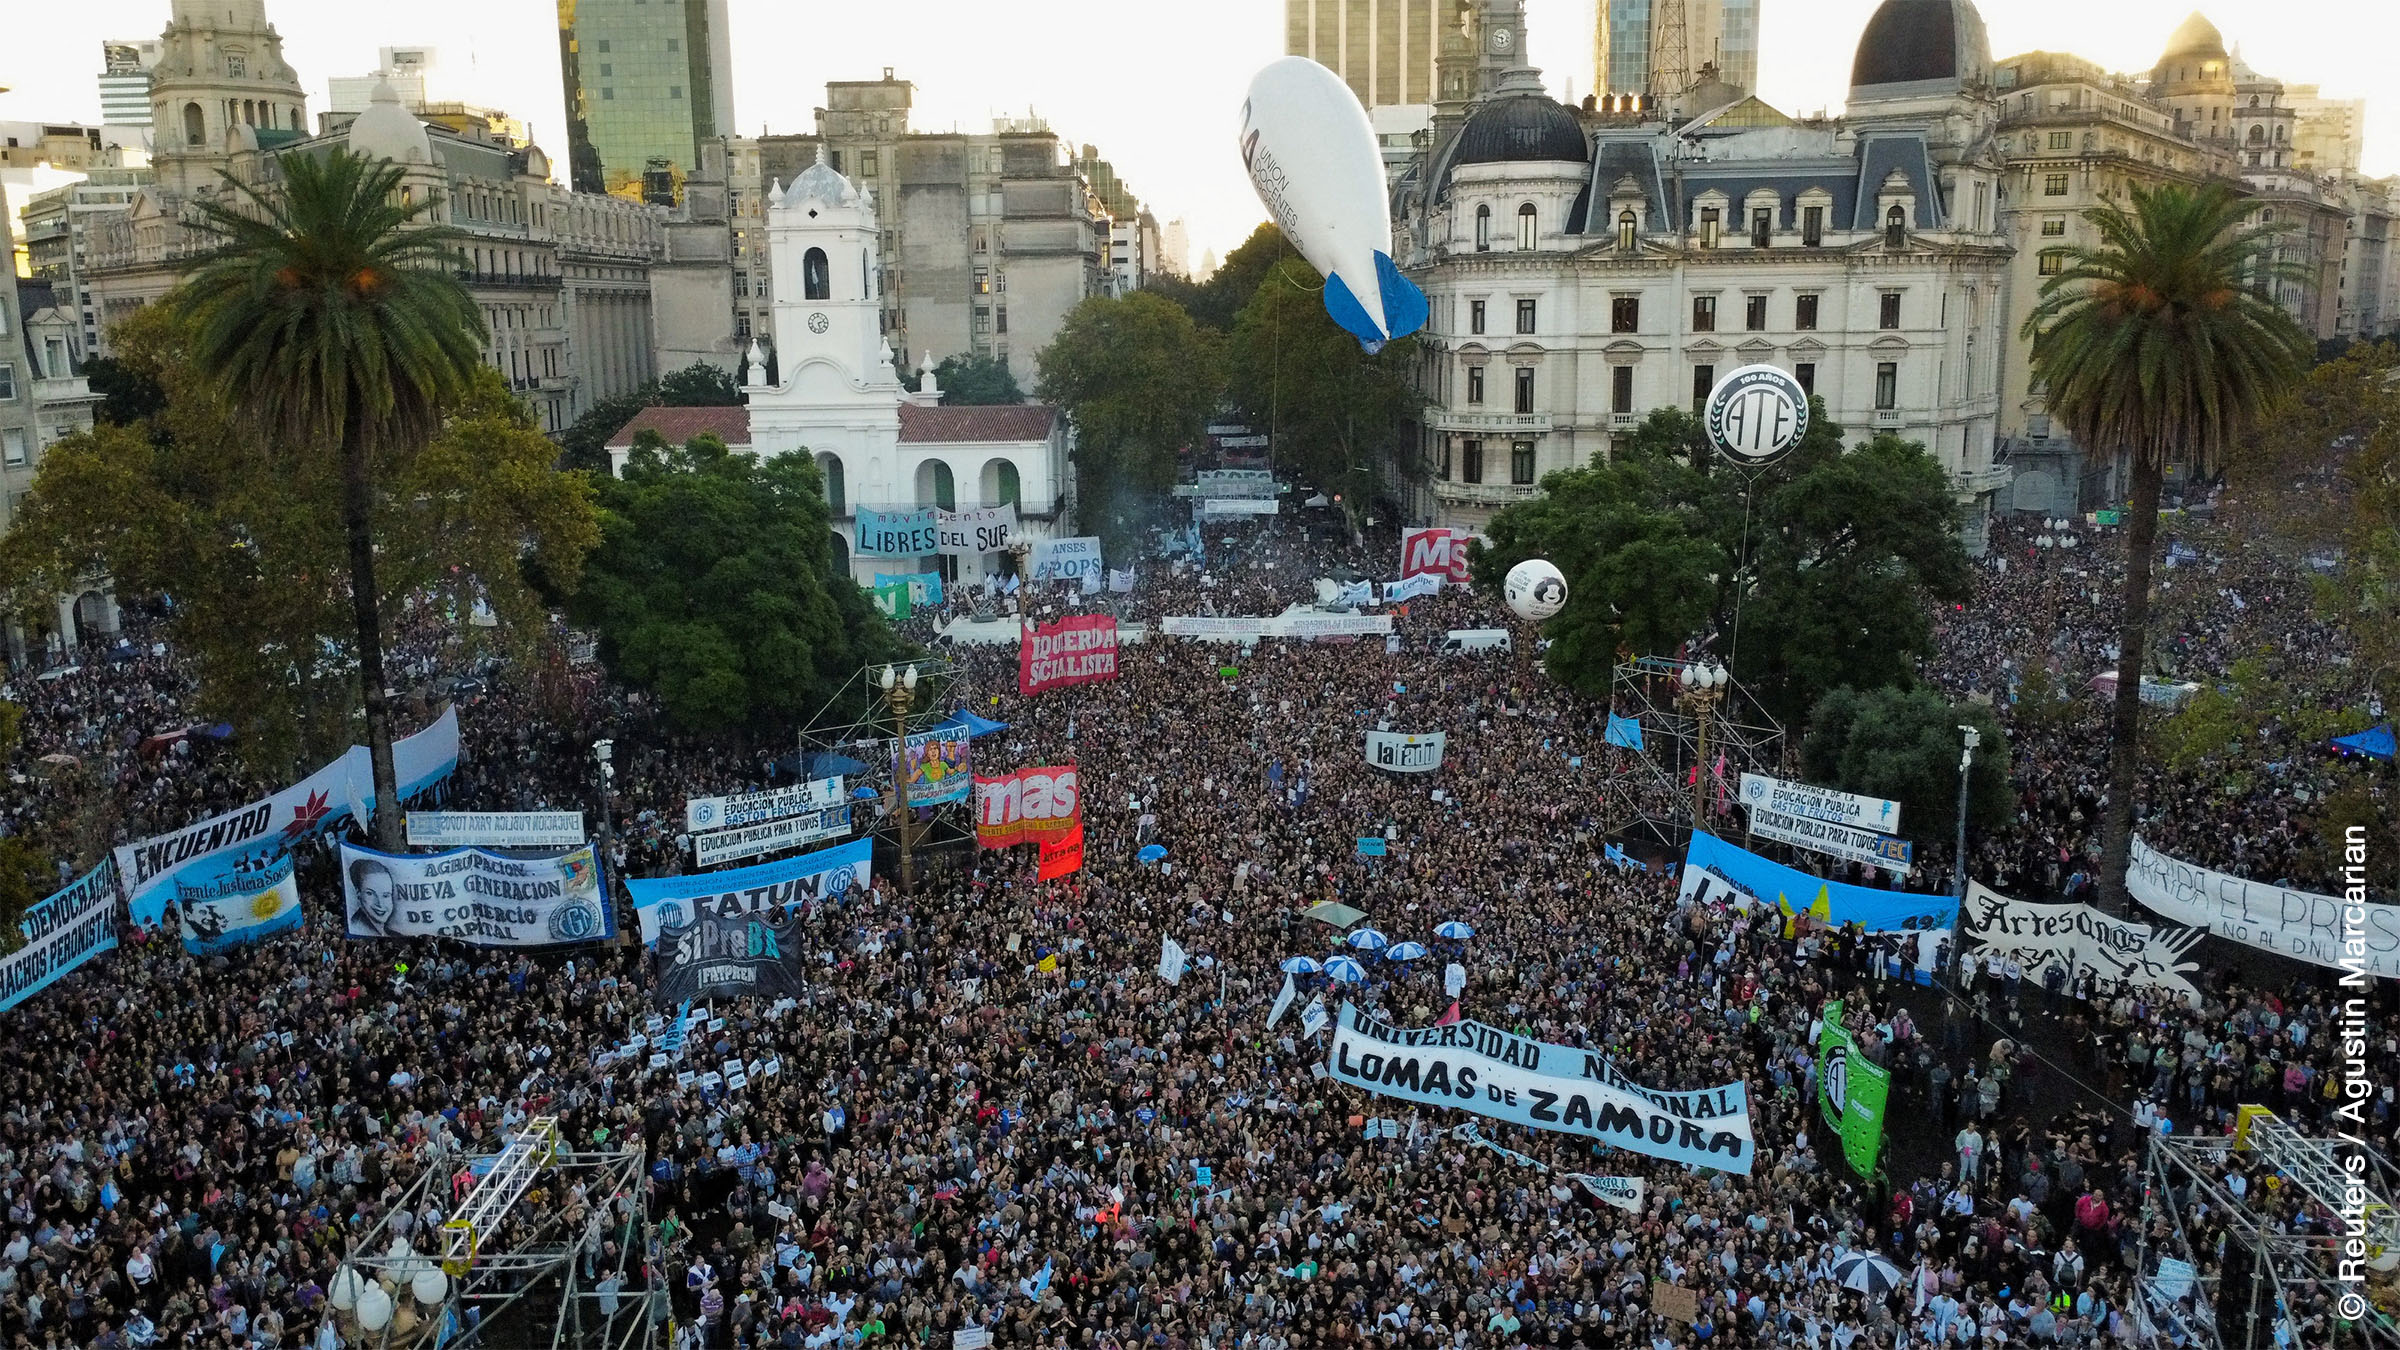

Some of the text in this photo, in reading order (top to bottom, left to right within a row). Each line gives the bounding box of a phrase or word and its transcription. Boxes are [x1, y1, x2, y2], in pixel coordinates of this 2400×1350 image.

[1259, 145, 1289, 191] UNION
[1254, 158, 1298, 227] DOCENTES
[1251, 173, 1305, 251] ARGENTINOS
[1740, 371, 1786, 387] 100 AÑOS
[1725, 388, 1790, 451] ATE
[941, 530, 969, 547] DEL
[976, 523, 1009, 552] SUR
[1052, 542, 1086, 554] ANSES
[783, 786, 794, 794] DE
[983, 772, 1077, 825] mas
[1830, 790, 1841, 798] DE
[1845, 792, 1855, 802] LA
[725, 804, 809, 825] GASTON FRUTOS
[1770, 800, 1806, 815] GASTON
[1808, 806, 1844, 822] FRUTOS
[134, 802, 273, 885] ENCUENTRO
[794, 837, 804, 845] DE
[1828, 826, 1848, 845] PARA
[1851, 831, 1878, 852] TODOS
[1846, 850, 1855, 859] DE
[28, 860, 115, 943] DEMOCRACIA
[396, 880, 456, 902] NUEVA
[692, 874, 822, 918] FATUN
[2219, 879, 2259, 924] EL
[407, 910, 434, 924] DE
[2223, 921, 2248, 940] NO
[2260, 930, 2279, 950] AL
[2292, 937, 2337, 964] DNU
[1353, 1012, 1738, 1119] UNIVERSIDAD NAONAL
[1337, 1042, 1742, 1159] LOMAS DE ZAMORA
